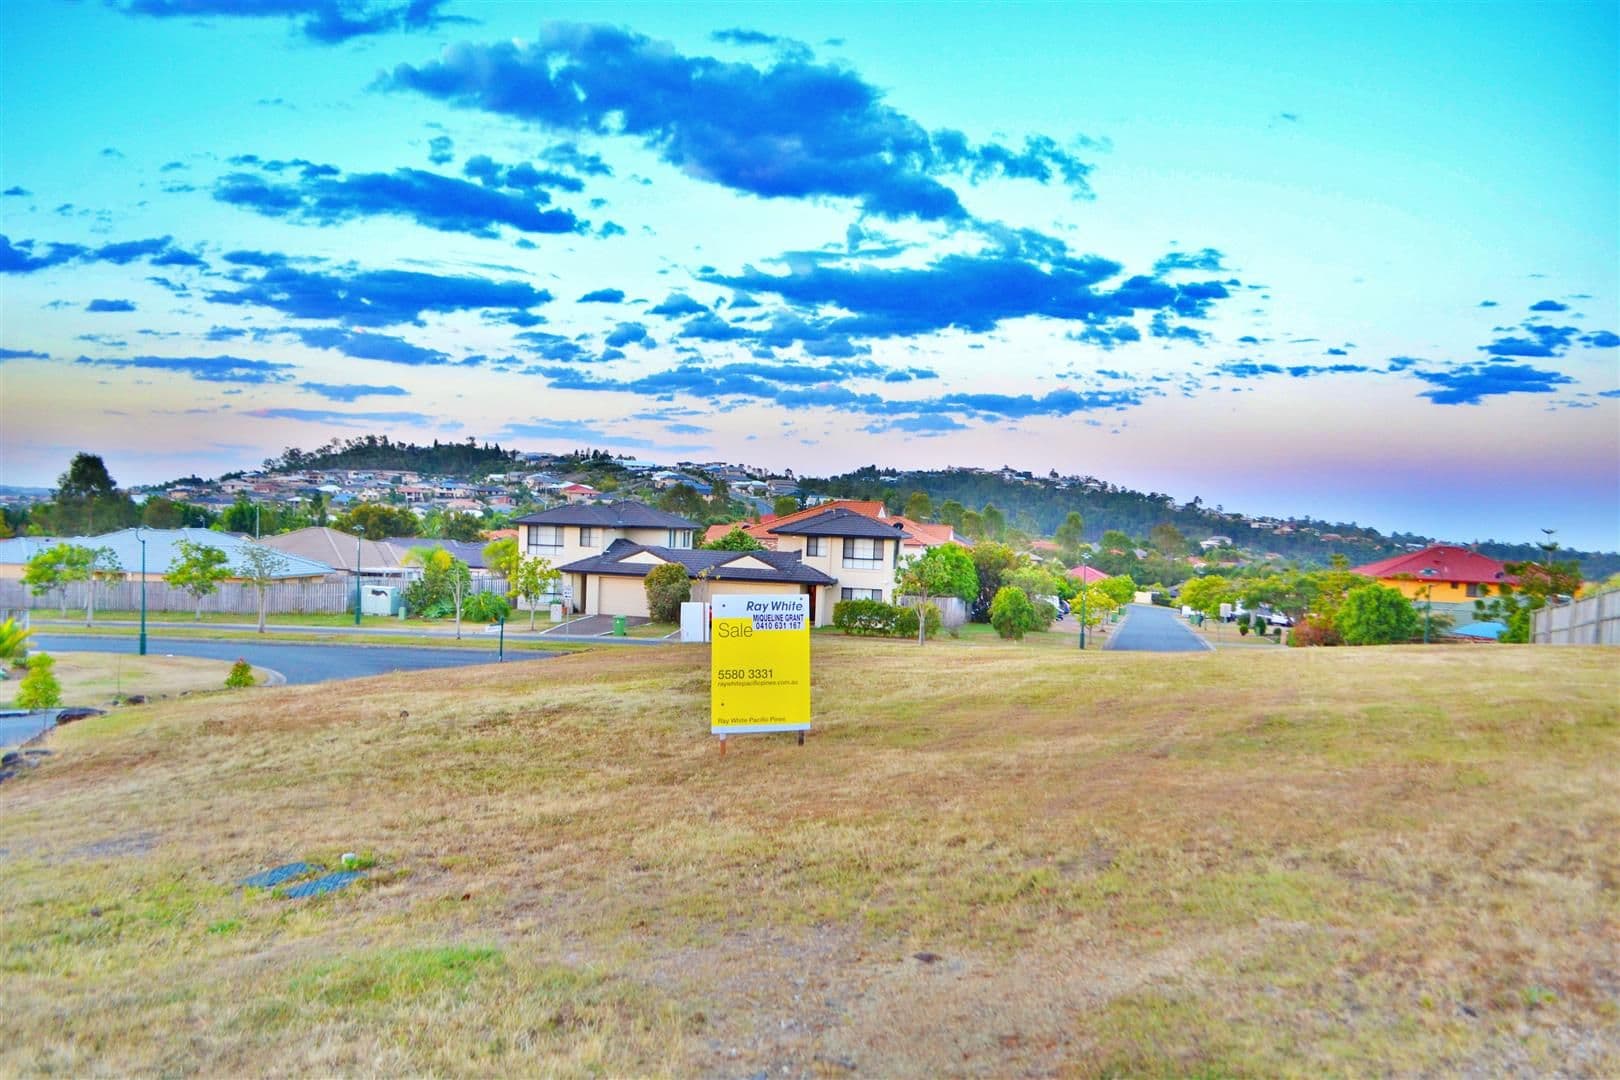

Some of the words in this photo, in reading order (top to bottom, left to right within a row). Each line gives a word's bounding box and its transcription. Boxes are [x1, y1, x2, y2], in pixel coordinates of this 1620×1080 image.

[746, 601, 769, 613] Ray
[771, 601, 803, 611] White
[752, 614, 784, 622] MIQUELINE
[785, 614, 804, 622] GRANT
[718, 622, 753, 638] Sale
[718, 669, 745, 680] 5580
[748, 668, 773, 679] 3331
